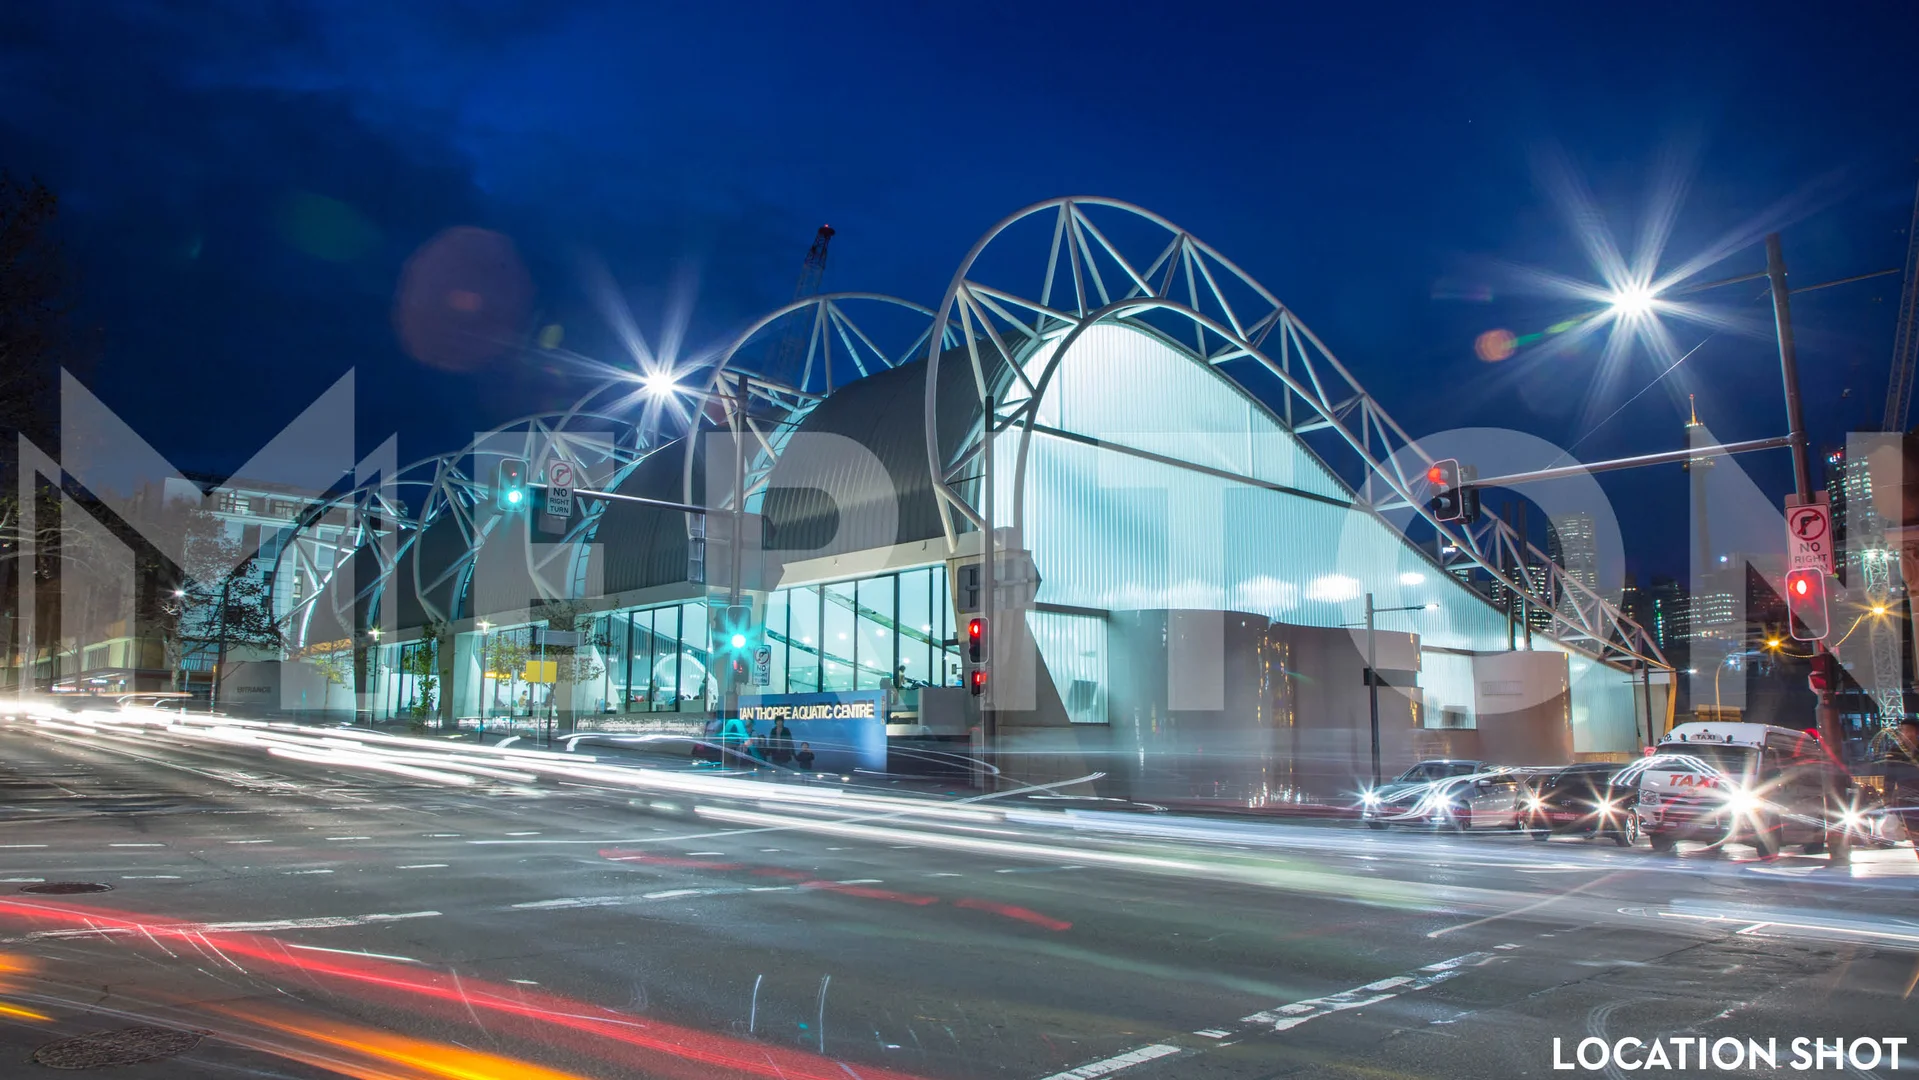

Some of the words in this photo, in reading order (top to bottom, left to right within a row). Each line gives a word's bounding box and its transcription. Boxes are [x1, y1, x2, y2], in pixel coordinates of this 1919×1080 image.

[553, 487, 567, 497] NO
[550, 497, 570, 506] RIGHT
[550, 505, 569, 514] TURN
[1799, 542, 1820, 552] NO
[1795, 554, 1827, 563] RIGHT
[740, 707, 754, 720] IAN
[755, 706, 791, 720] THORPE
[791, 704, 833, 720] AQUATIC
[833, 703, 874, 719] CENTRE
[1669, 774, 1719, 788] TAXI
